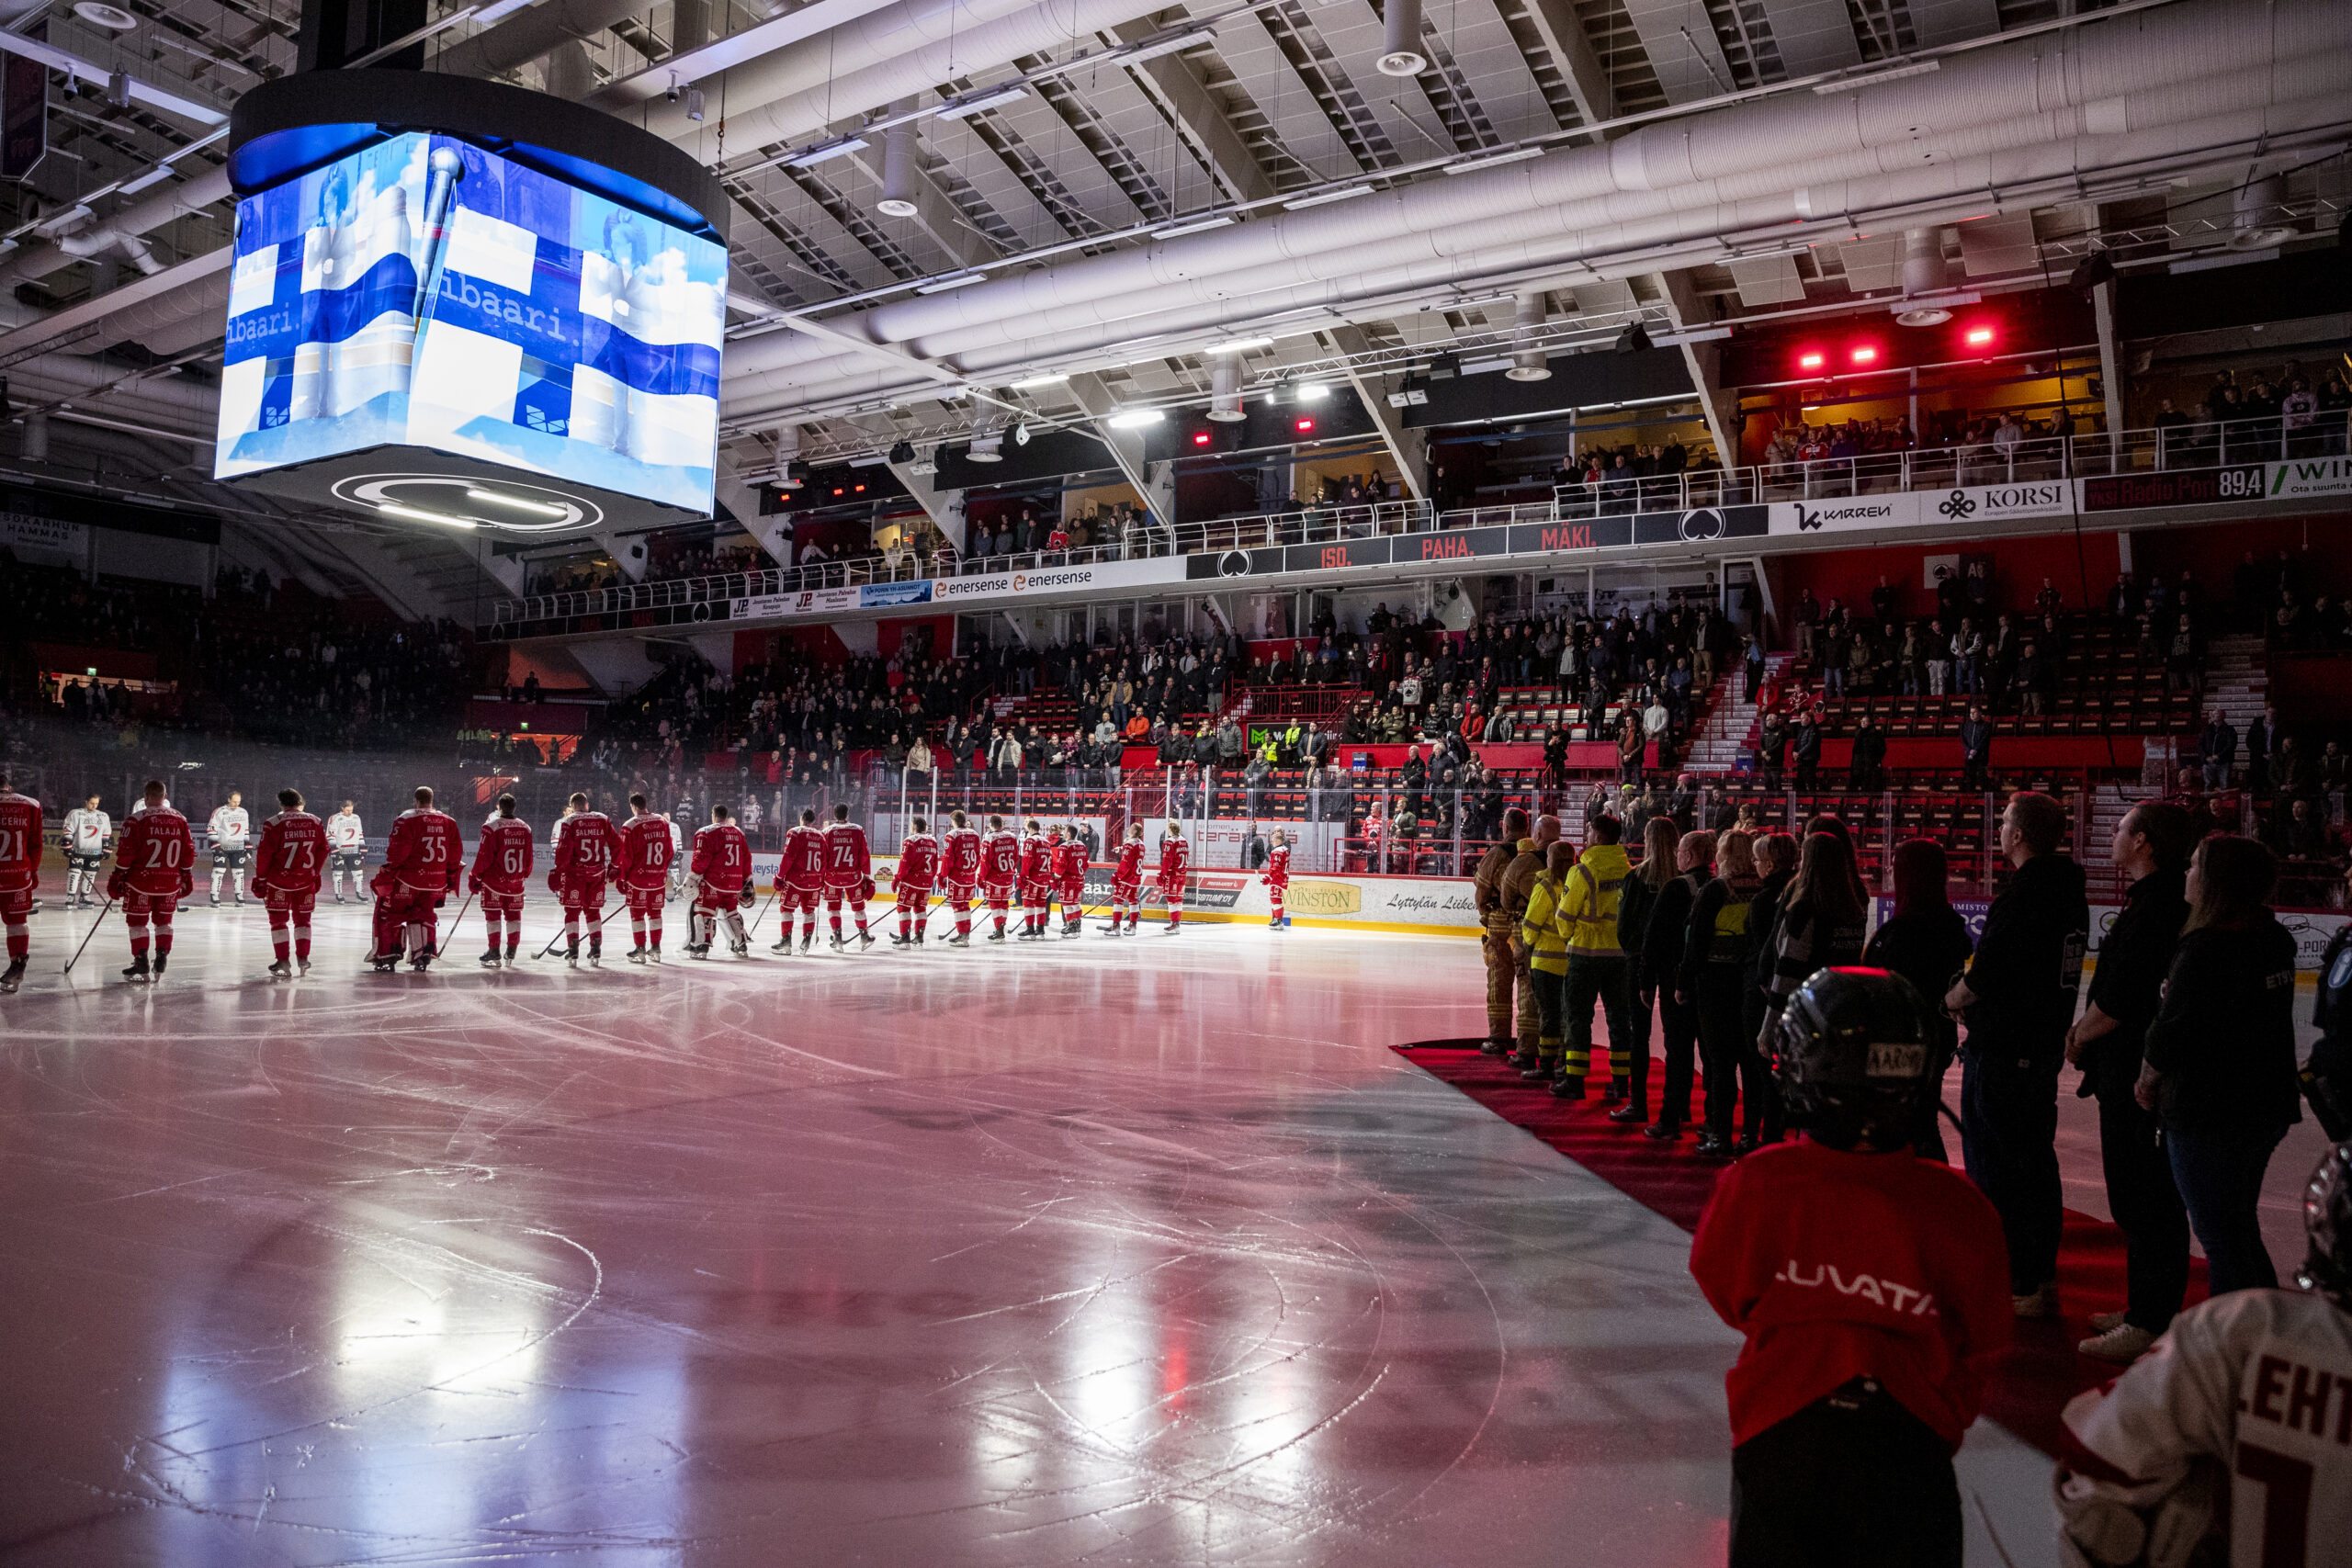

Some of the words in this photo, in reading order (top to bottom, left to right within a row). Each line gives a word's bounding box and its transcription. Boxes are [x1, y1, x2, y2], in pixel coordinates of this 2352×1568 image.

[441, 268, 580, 347] ibaari.
[226, 302, 300, 344] ibaari.
[2219, 469, 2262, 497] 89,4
[2290, 485, 2310, 493] Ota
[2312, 483, 2347, 492] suunta
[1985, 486, 2063, 509] KORSI
[7, 524, 69, 540] HAMMAS
[1541, 525, 1598, 550] MÄKI.
[1321, 547, 1352, 569] ISO.
[1421, 537, 1475, 560] PAHA.
[949, 578, 1008, 595] enersense
[1029, 570, 1091, 588] enersense
[734, 599, 750, 614] JP
[797, 592, 813, 608] JP
[150, 827, 181, 837] TALAJA
[575, 829, 605, 837] SALMELA
[0, 830, 24, 862] 21
[146, 838, 182, 868] 20
[284, 840, 315, 869] 73
[421, 836, 447, 863] 35
[579, 839, 600, 863] 51
[646, 842, 664, 866] 18
[724, 843, 740, 866] 31
[832, 846, 854, 868] 74
[503, 848, 524, 874] 61
[806, 851, 821, 872] 16
[923, 854, 933, 874] 3
[961, 849, 977, 870] 39
[998, 852, 1015, 873] 66
[1077, 858, 1084, 874] 8
[1282, 889, 1350, 908] WINSTON
[1387, 893, 1438, 908] Lyttylän
[2237, 1354, 2352, 1448] EHT
